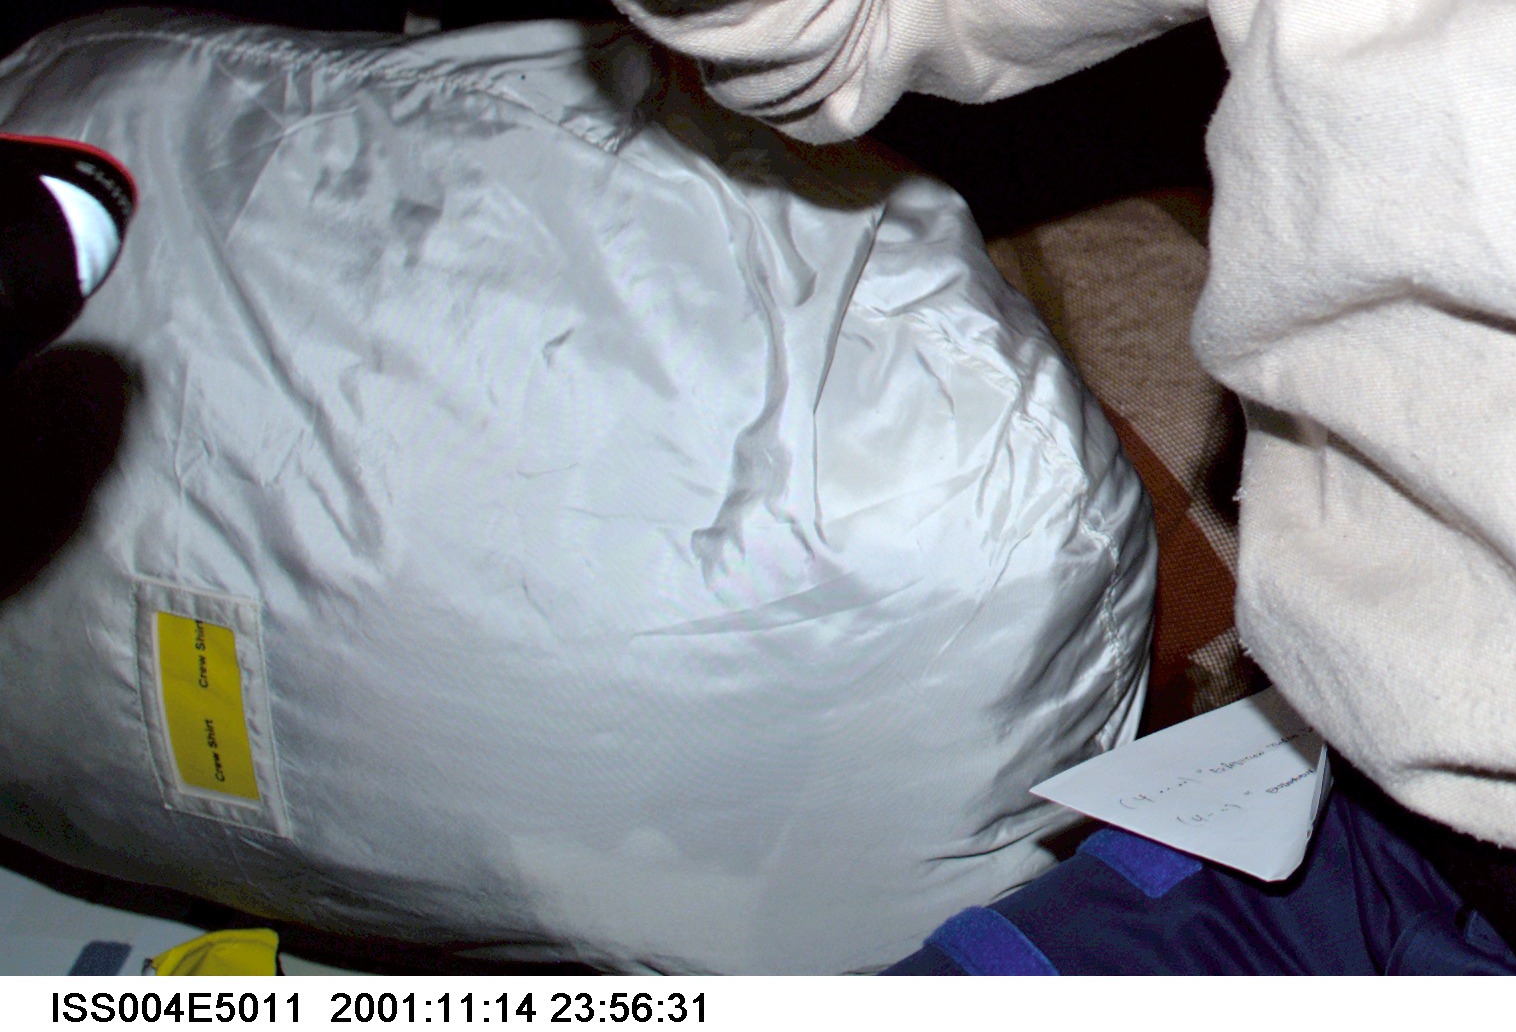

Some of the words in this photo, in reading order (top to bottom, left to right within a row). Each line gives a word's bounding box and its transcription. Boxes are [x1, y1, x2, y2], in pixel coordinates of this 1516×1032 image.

[194, 620, 206, 651] Shirt
[198, 655, 208, 689] Crew
[205, 719, 217, 749] Shirt
[213, 752, 225, 782] Crew
